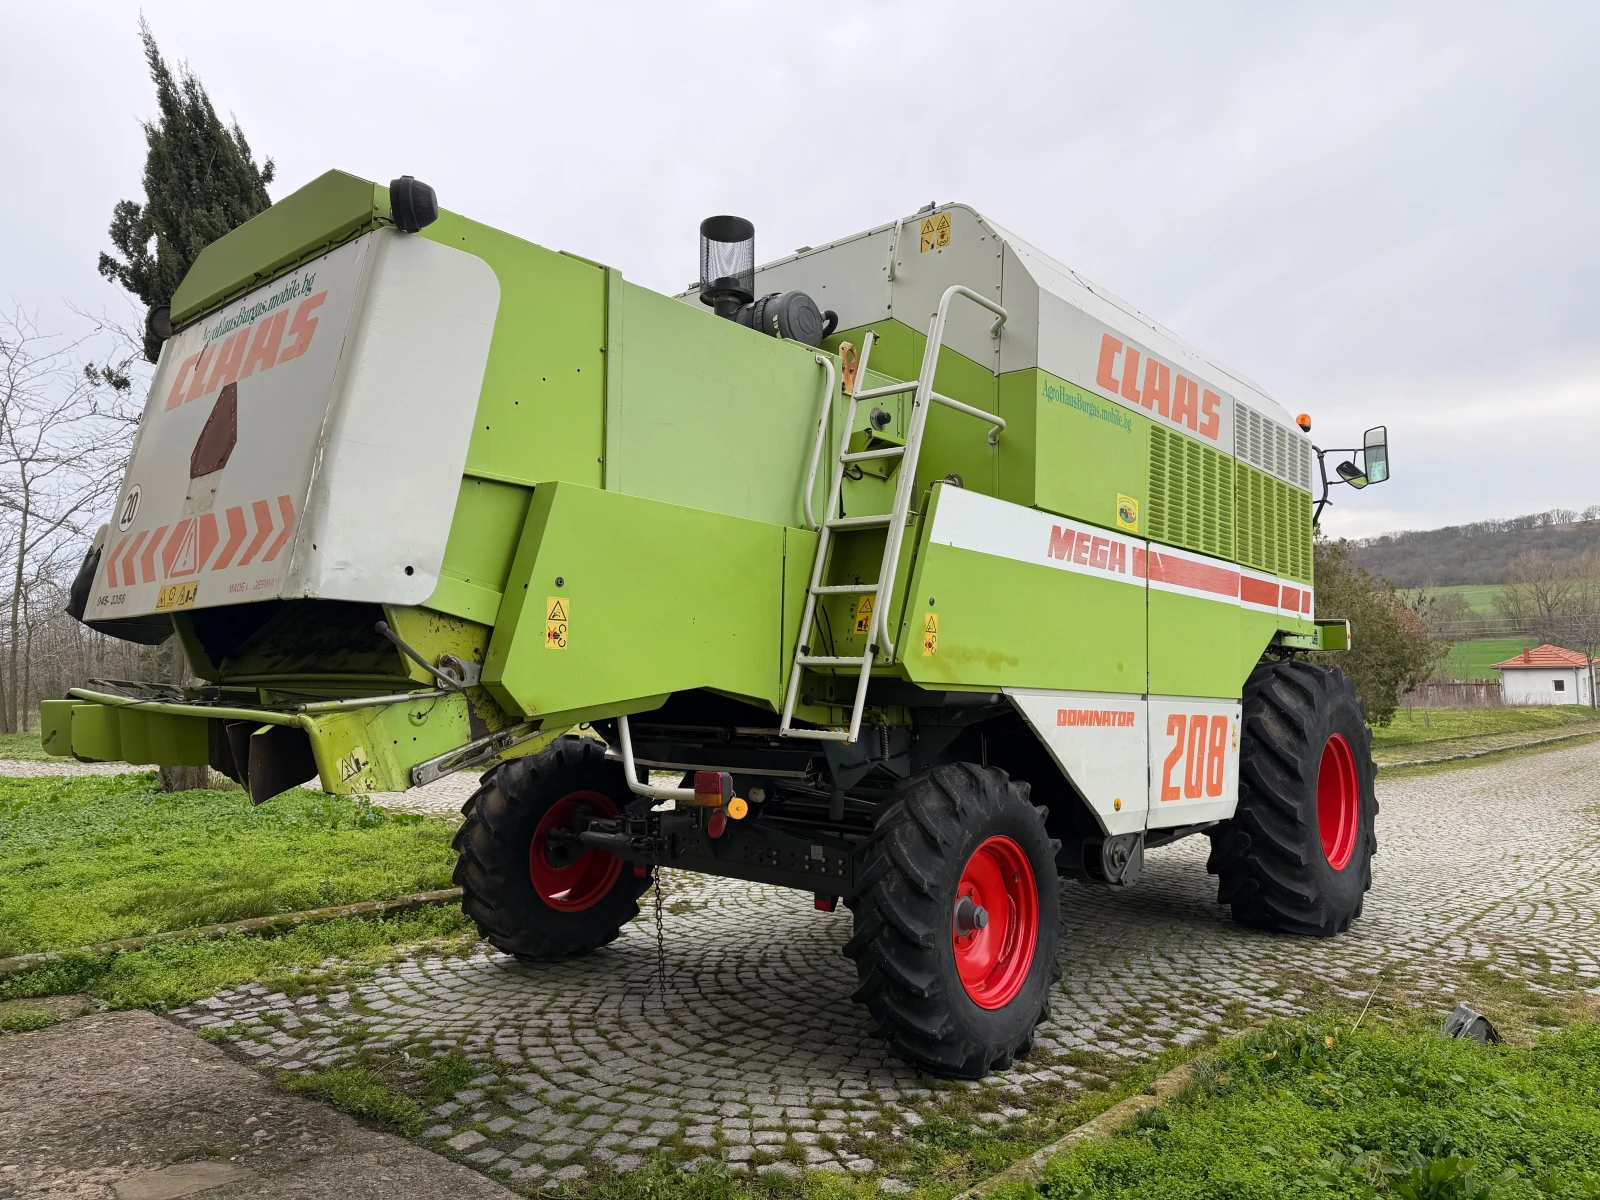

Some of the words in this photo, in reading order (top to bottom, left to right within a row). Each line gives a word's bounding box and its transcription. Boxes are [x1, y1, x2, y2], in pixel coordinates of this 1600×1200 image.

[164, 289, 328, 412] CLAAS
[1042, 379, 1132, 434] AgroHausBurgas.mobile.bg
[1096, 333, 1221, 441] CLAAS
[120, 491, 139, 525] 20
[1047, 524, 1126, 574] MEGA
[1056, 709, 1136, 727] DOMINATOR
[1160, 714, 1228, 802] 208
